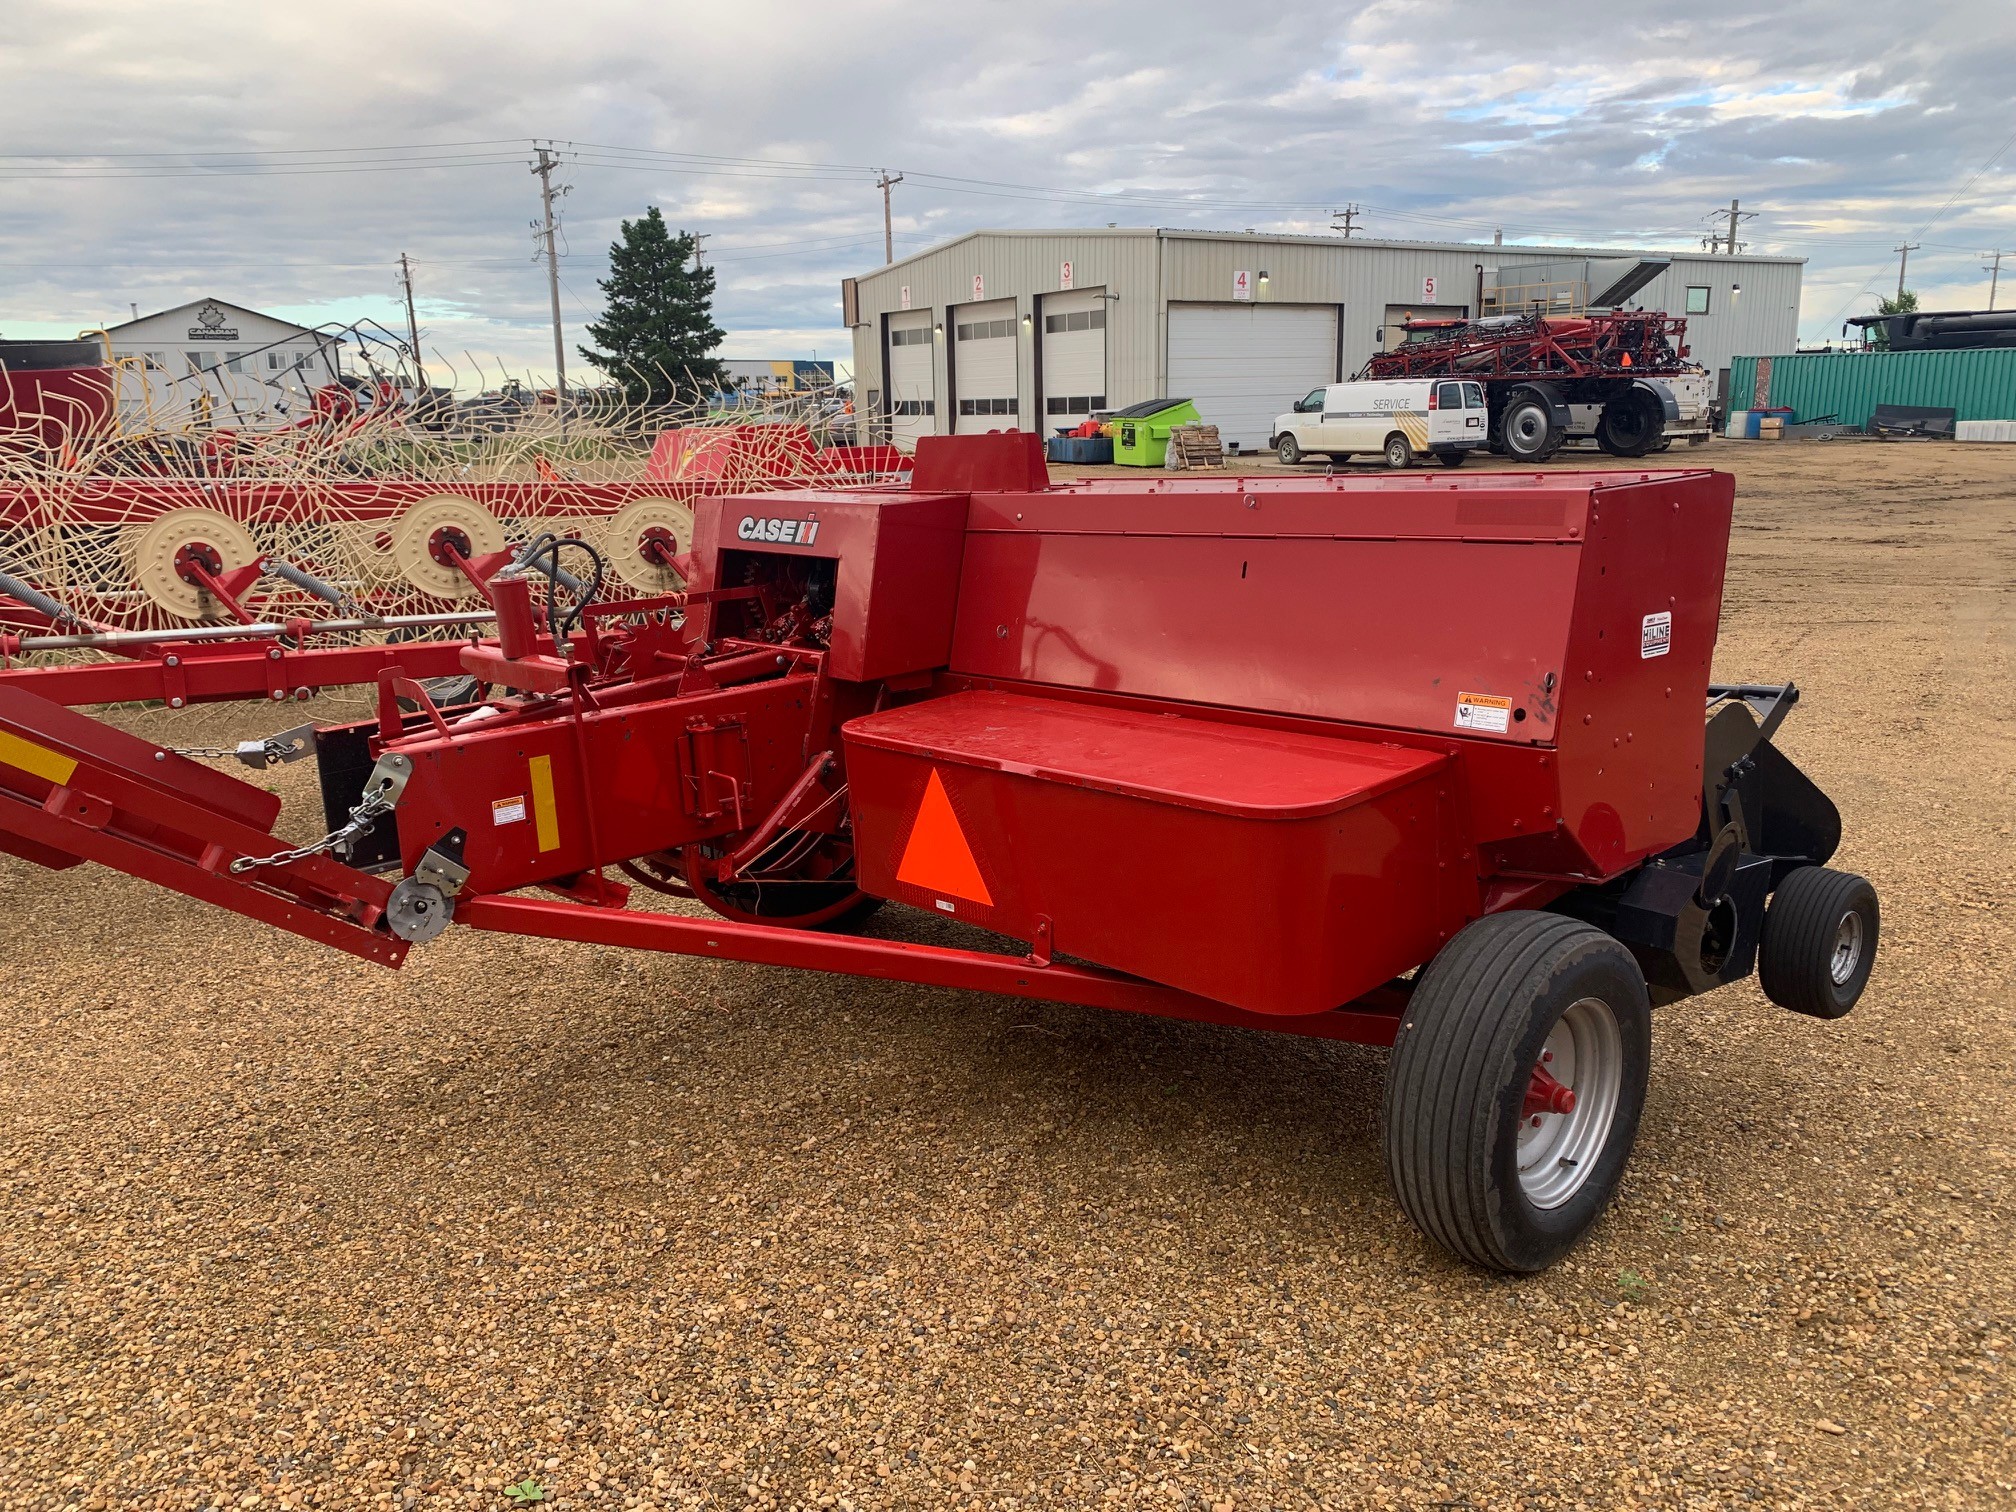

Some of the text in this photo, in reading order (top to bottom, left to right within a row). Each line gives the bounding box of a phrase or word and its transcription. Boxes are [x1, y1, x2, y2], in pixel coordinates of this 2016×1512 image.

[1063, 262, 1071, 279] 3
[975, 276, 982, 291] 2
[1237, 272, 1247, 289] 4
[1425, 278, 1434, 293] 5
[1373, 398, 1411, 410] SERVICE
[738, 516, 798, 543] CASE
[1473, 697, 1506, 707] WARNING
